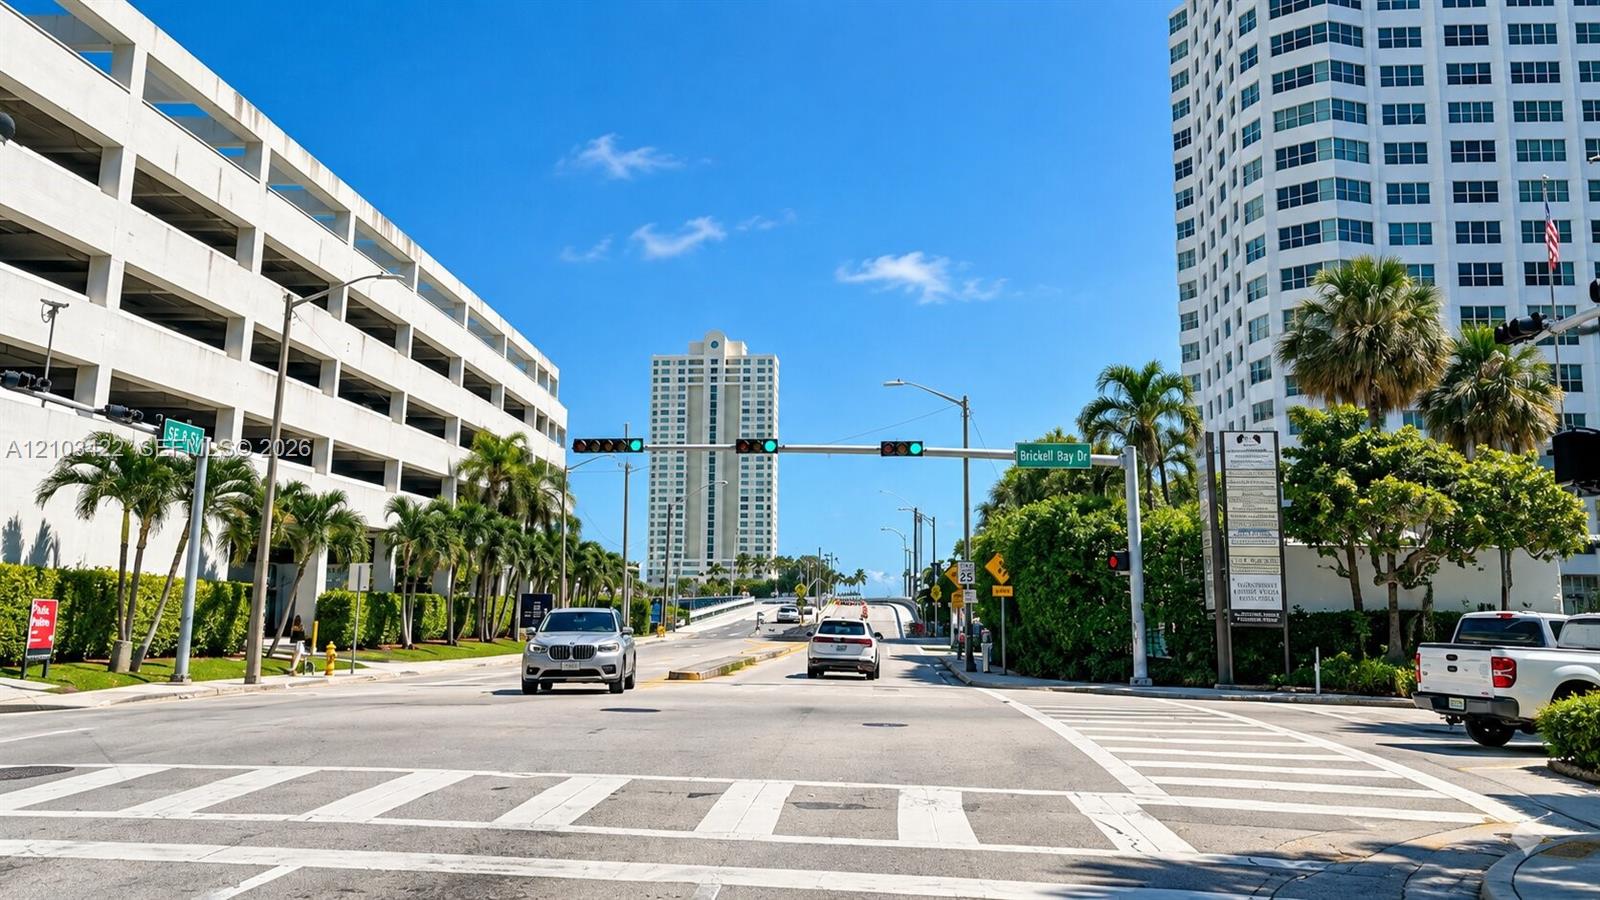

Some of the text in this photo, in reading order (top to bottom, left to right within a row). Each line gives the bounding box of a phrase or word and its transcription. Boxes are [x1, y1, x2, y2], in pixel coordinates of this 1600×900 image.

[168, 426, 180, 441] SE
[191, 431, 201, 447] St
[1020, 449, 1088, 465] Brickell Bay Dr
[960, 572, 973, 582] 25
